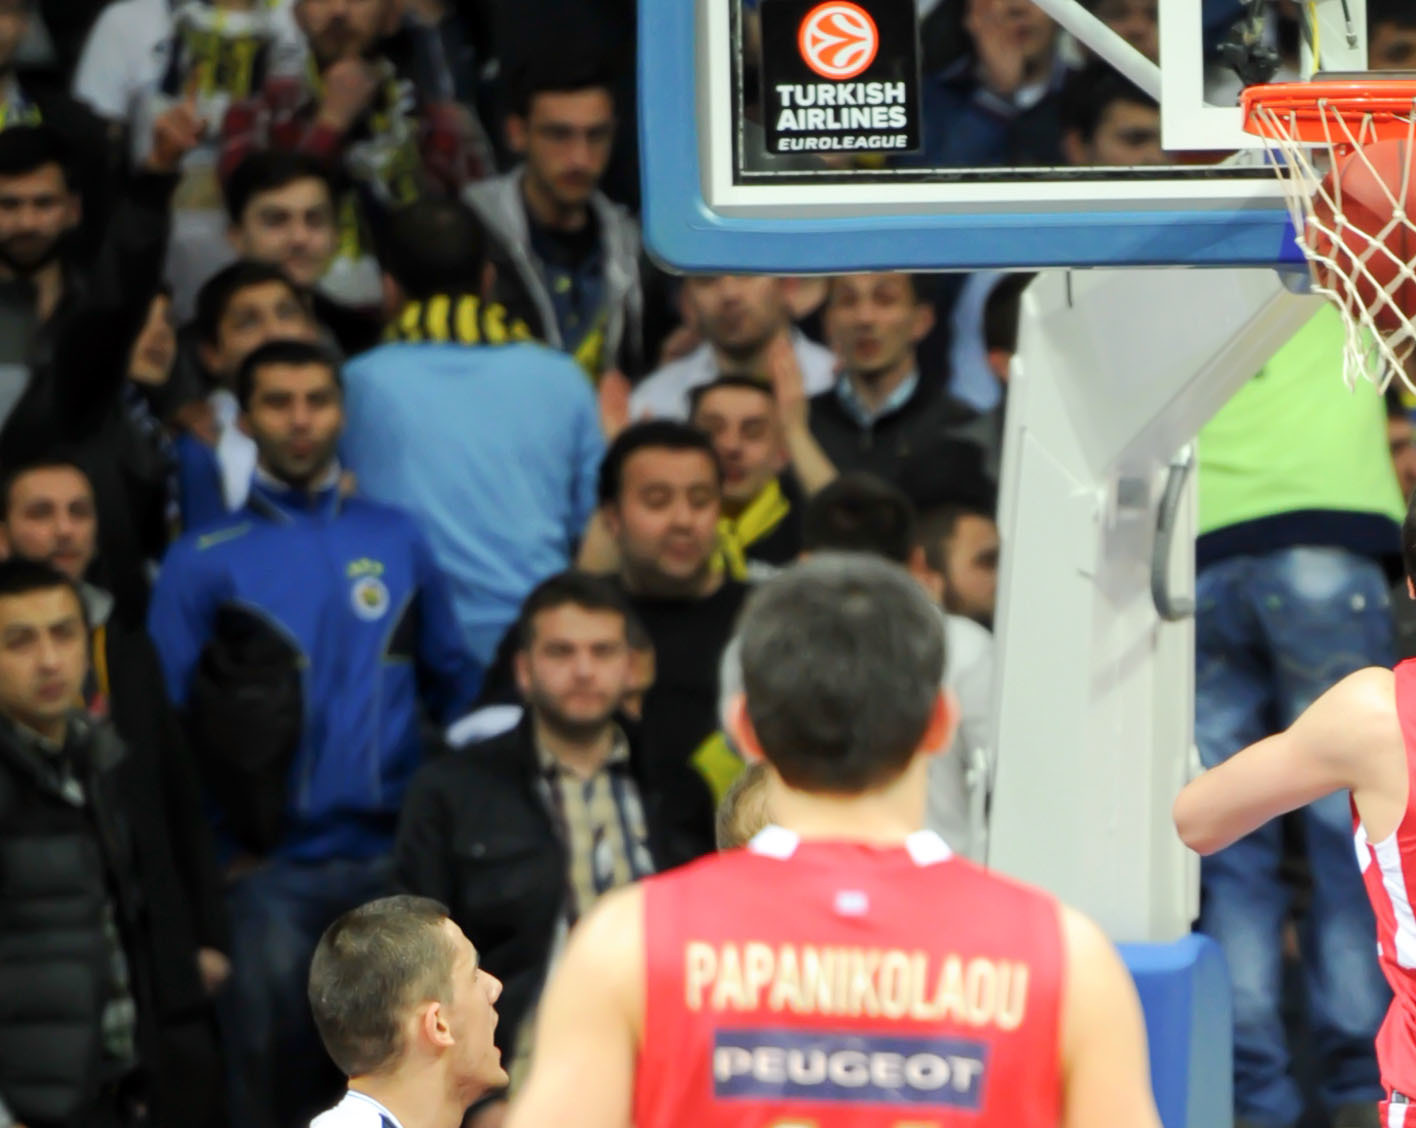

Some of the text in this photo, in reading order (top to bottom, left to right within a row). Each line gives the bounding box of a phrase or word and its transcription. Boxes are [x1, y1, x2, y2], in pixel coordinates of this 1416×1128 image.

[776, 82, 906, 107] TURKISH
[776, 105, 907, 131] AIRLINES
[778, 135, 908, 151] EUROLEAGUE
[685, 941, 1028, 1031] PAPANIKOLAOU
[713, 1045, 984, 1094] PEUGEOT
